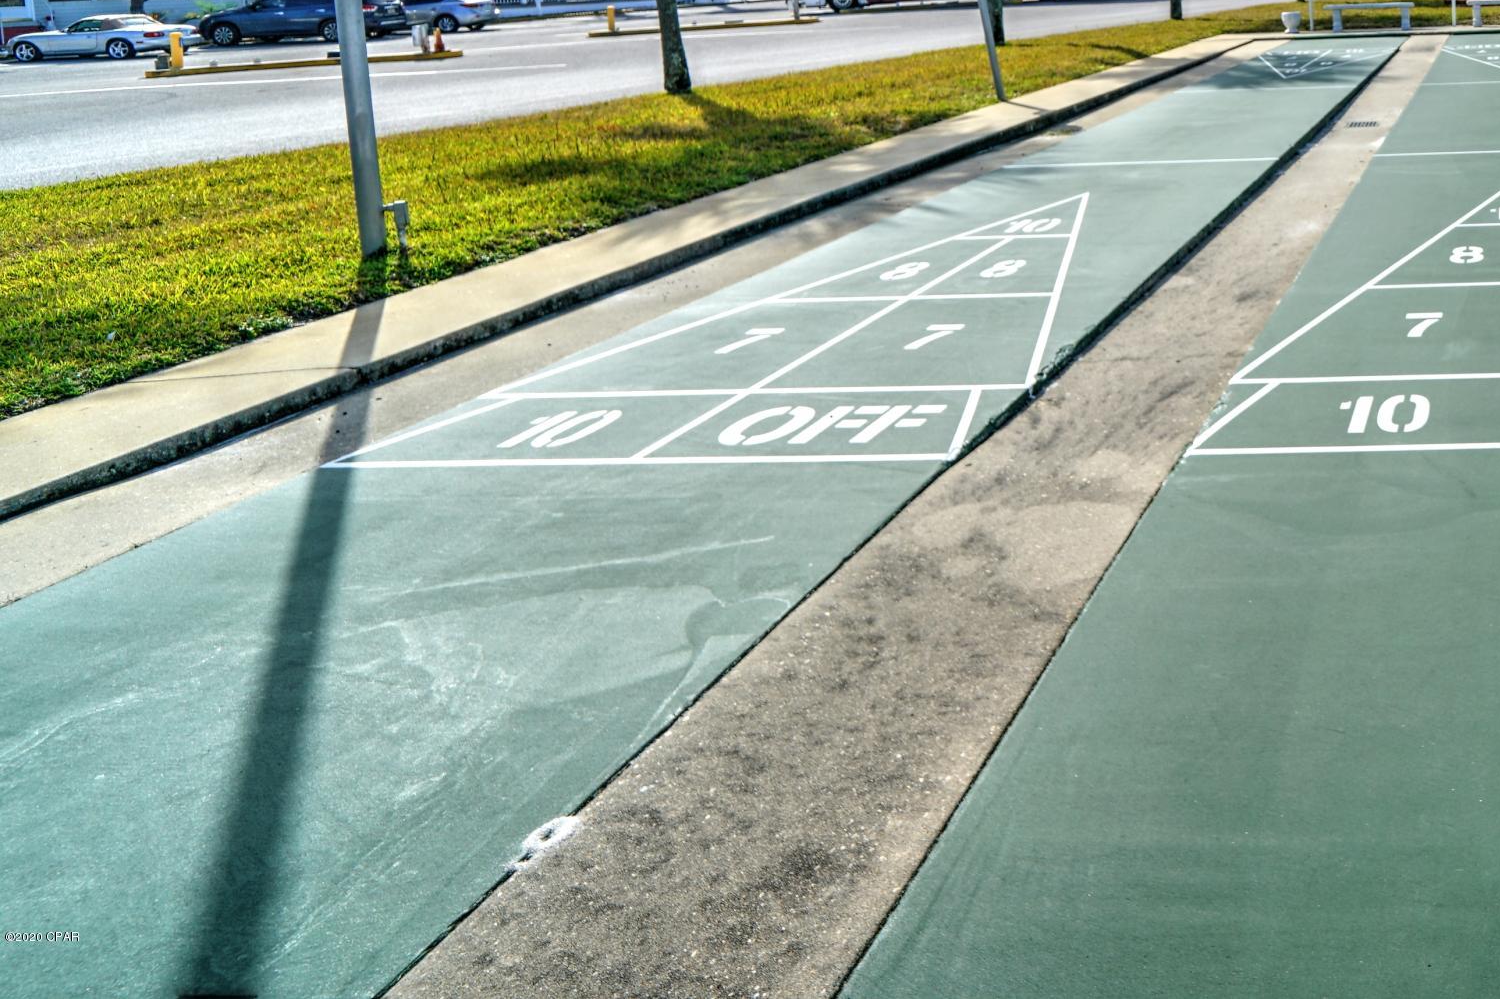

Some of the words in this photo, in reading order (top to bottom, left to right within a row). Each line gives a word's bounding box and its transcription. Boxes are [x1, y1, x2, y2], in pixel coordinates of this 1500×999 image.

[1003, 217, 1062, 234] 10
[1449, 245, 1485, 264] 8
[880, 261, 930, 282] 8
[979, 259, 1027, 278] 8
[903, 323, 966, 351] 7
[1405, 311, 1444, 338] 7
[713, 327, 786, 355] 7
[496, 409, 623, 449] 10
[717, 404, 948, 447] OFF
[1339, 393, 1431, 434] 10
